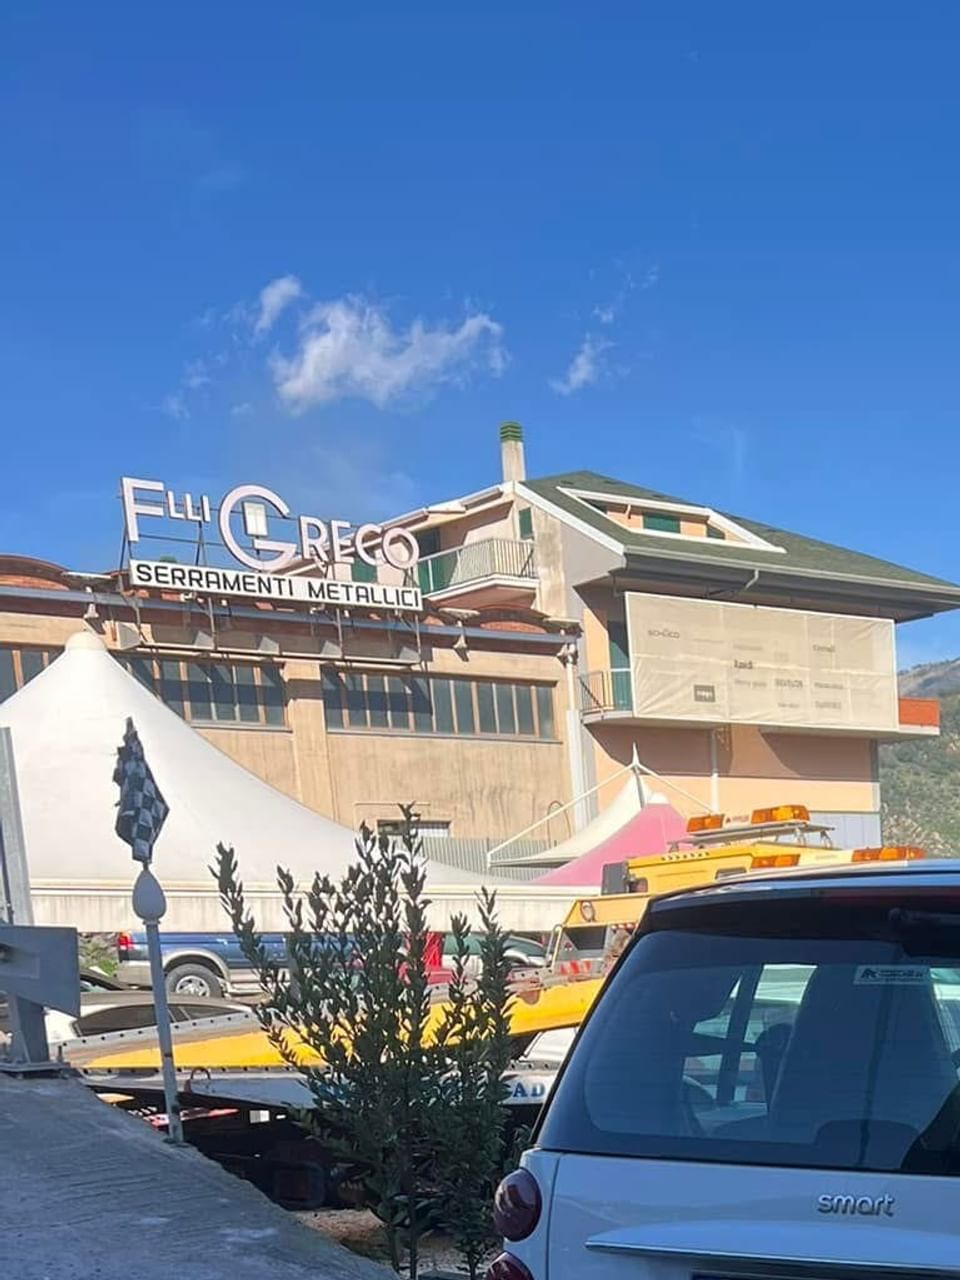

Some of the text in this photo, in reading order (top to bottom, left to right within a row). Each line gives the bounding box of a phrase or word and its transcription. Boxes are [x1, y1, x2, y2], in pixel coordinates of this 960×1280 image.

[218, 484, 420, 572] GRECO
[135, 562, 420, 608] SERRAMENTI METALLICI
[817, 1193, 895, 1217] smart
